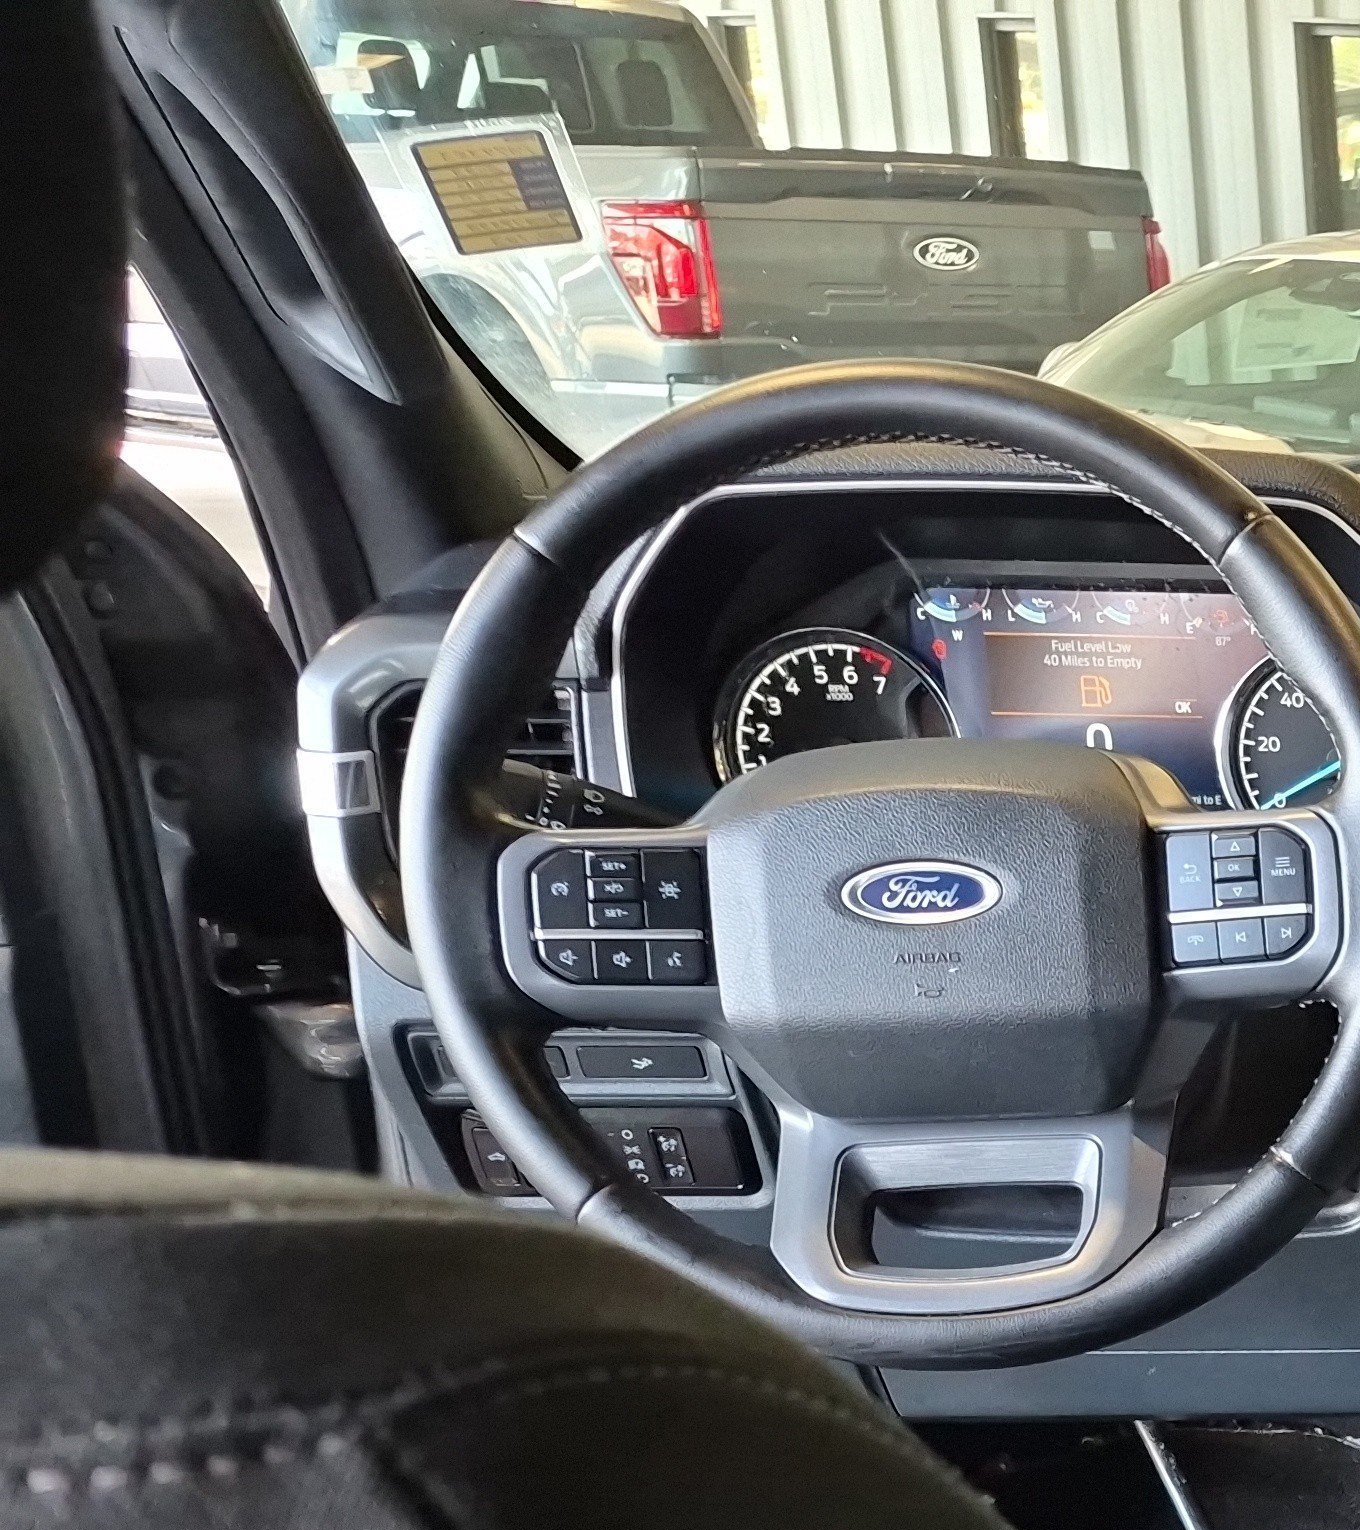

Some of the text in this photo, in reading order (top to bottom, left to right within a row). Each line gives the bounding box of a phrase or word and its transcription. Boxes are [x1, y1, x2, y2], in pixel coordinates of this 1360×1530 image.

[925, 241, 968, 265] Ford
[982, 609, 992, 621] H
[1007, 610, 1015, 621] L
[1072, 611, 1081, 623] H
[1096, 612, 1104, 623] C
[1160, 613, 1169, 625] H
[1186, 621, 1194, 634] E
[952, 629, 964, 641] W
[1052, 640, 1131, 653] Fuel Level Low
[1044, 654, 1142, 670] 40 Miles to Empty
[813, 665, 828, 684] 5
[843, 665, 859, 685] 6
[785, 678, 800, 696] 4
[828, 685, 849, 693] RPM
[872, 677, 887, 695] 7
[767, 697, 782, 716] 3
[1280, 692, 1304, 708] 40
[1176, 702, 1191, 714] OK
[756, 723, 772, 743] 2
[1257, 736, 1281, 753] 20
[1203, 795, 1213, 805] to
[1215, 795, 1222, 805] E
[1227, 864, 1240, 872] OK
[1270, 868, 1296, 877] MENU
[882, 875, 960, 909] Ford
[894, 952, 962, 964] AIRBAG
